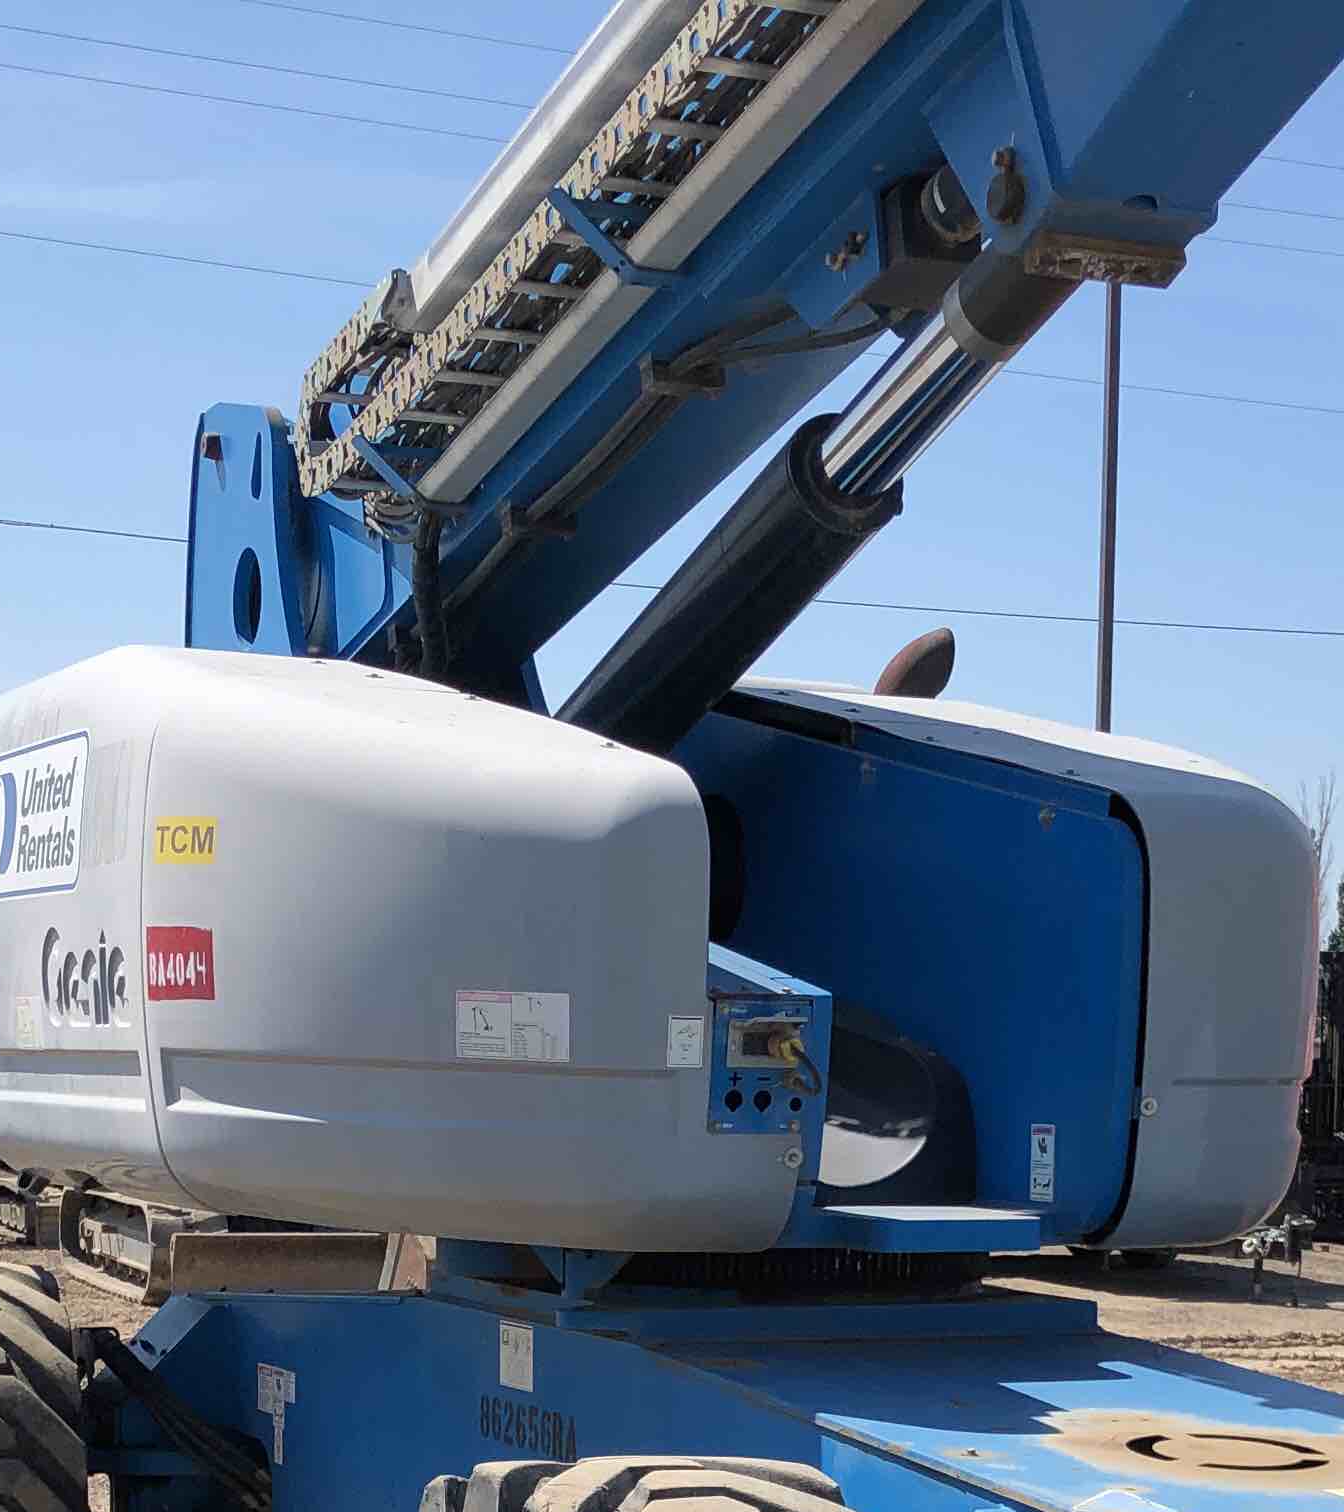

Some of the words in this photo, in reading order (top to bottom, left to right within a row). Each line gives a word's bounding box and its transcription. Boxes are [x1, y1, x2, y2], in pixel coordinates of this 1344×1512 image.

[20, 756, 78, 817] United
[16, 816, 76, 874] Rentals
[156, 825, 214, 854] TCM
[149, 951, 206, 987] BA4044
